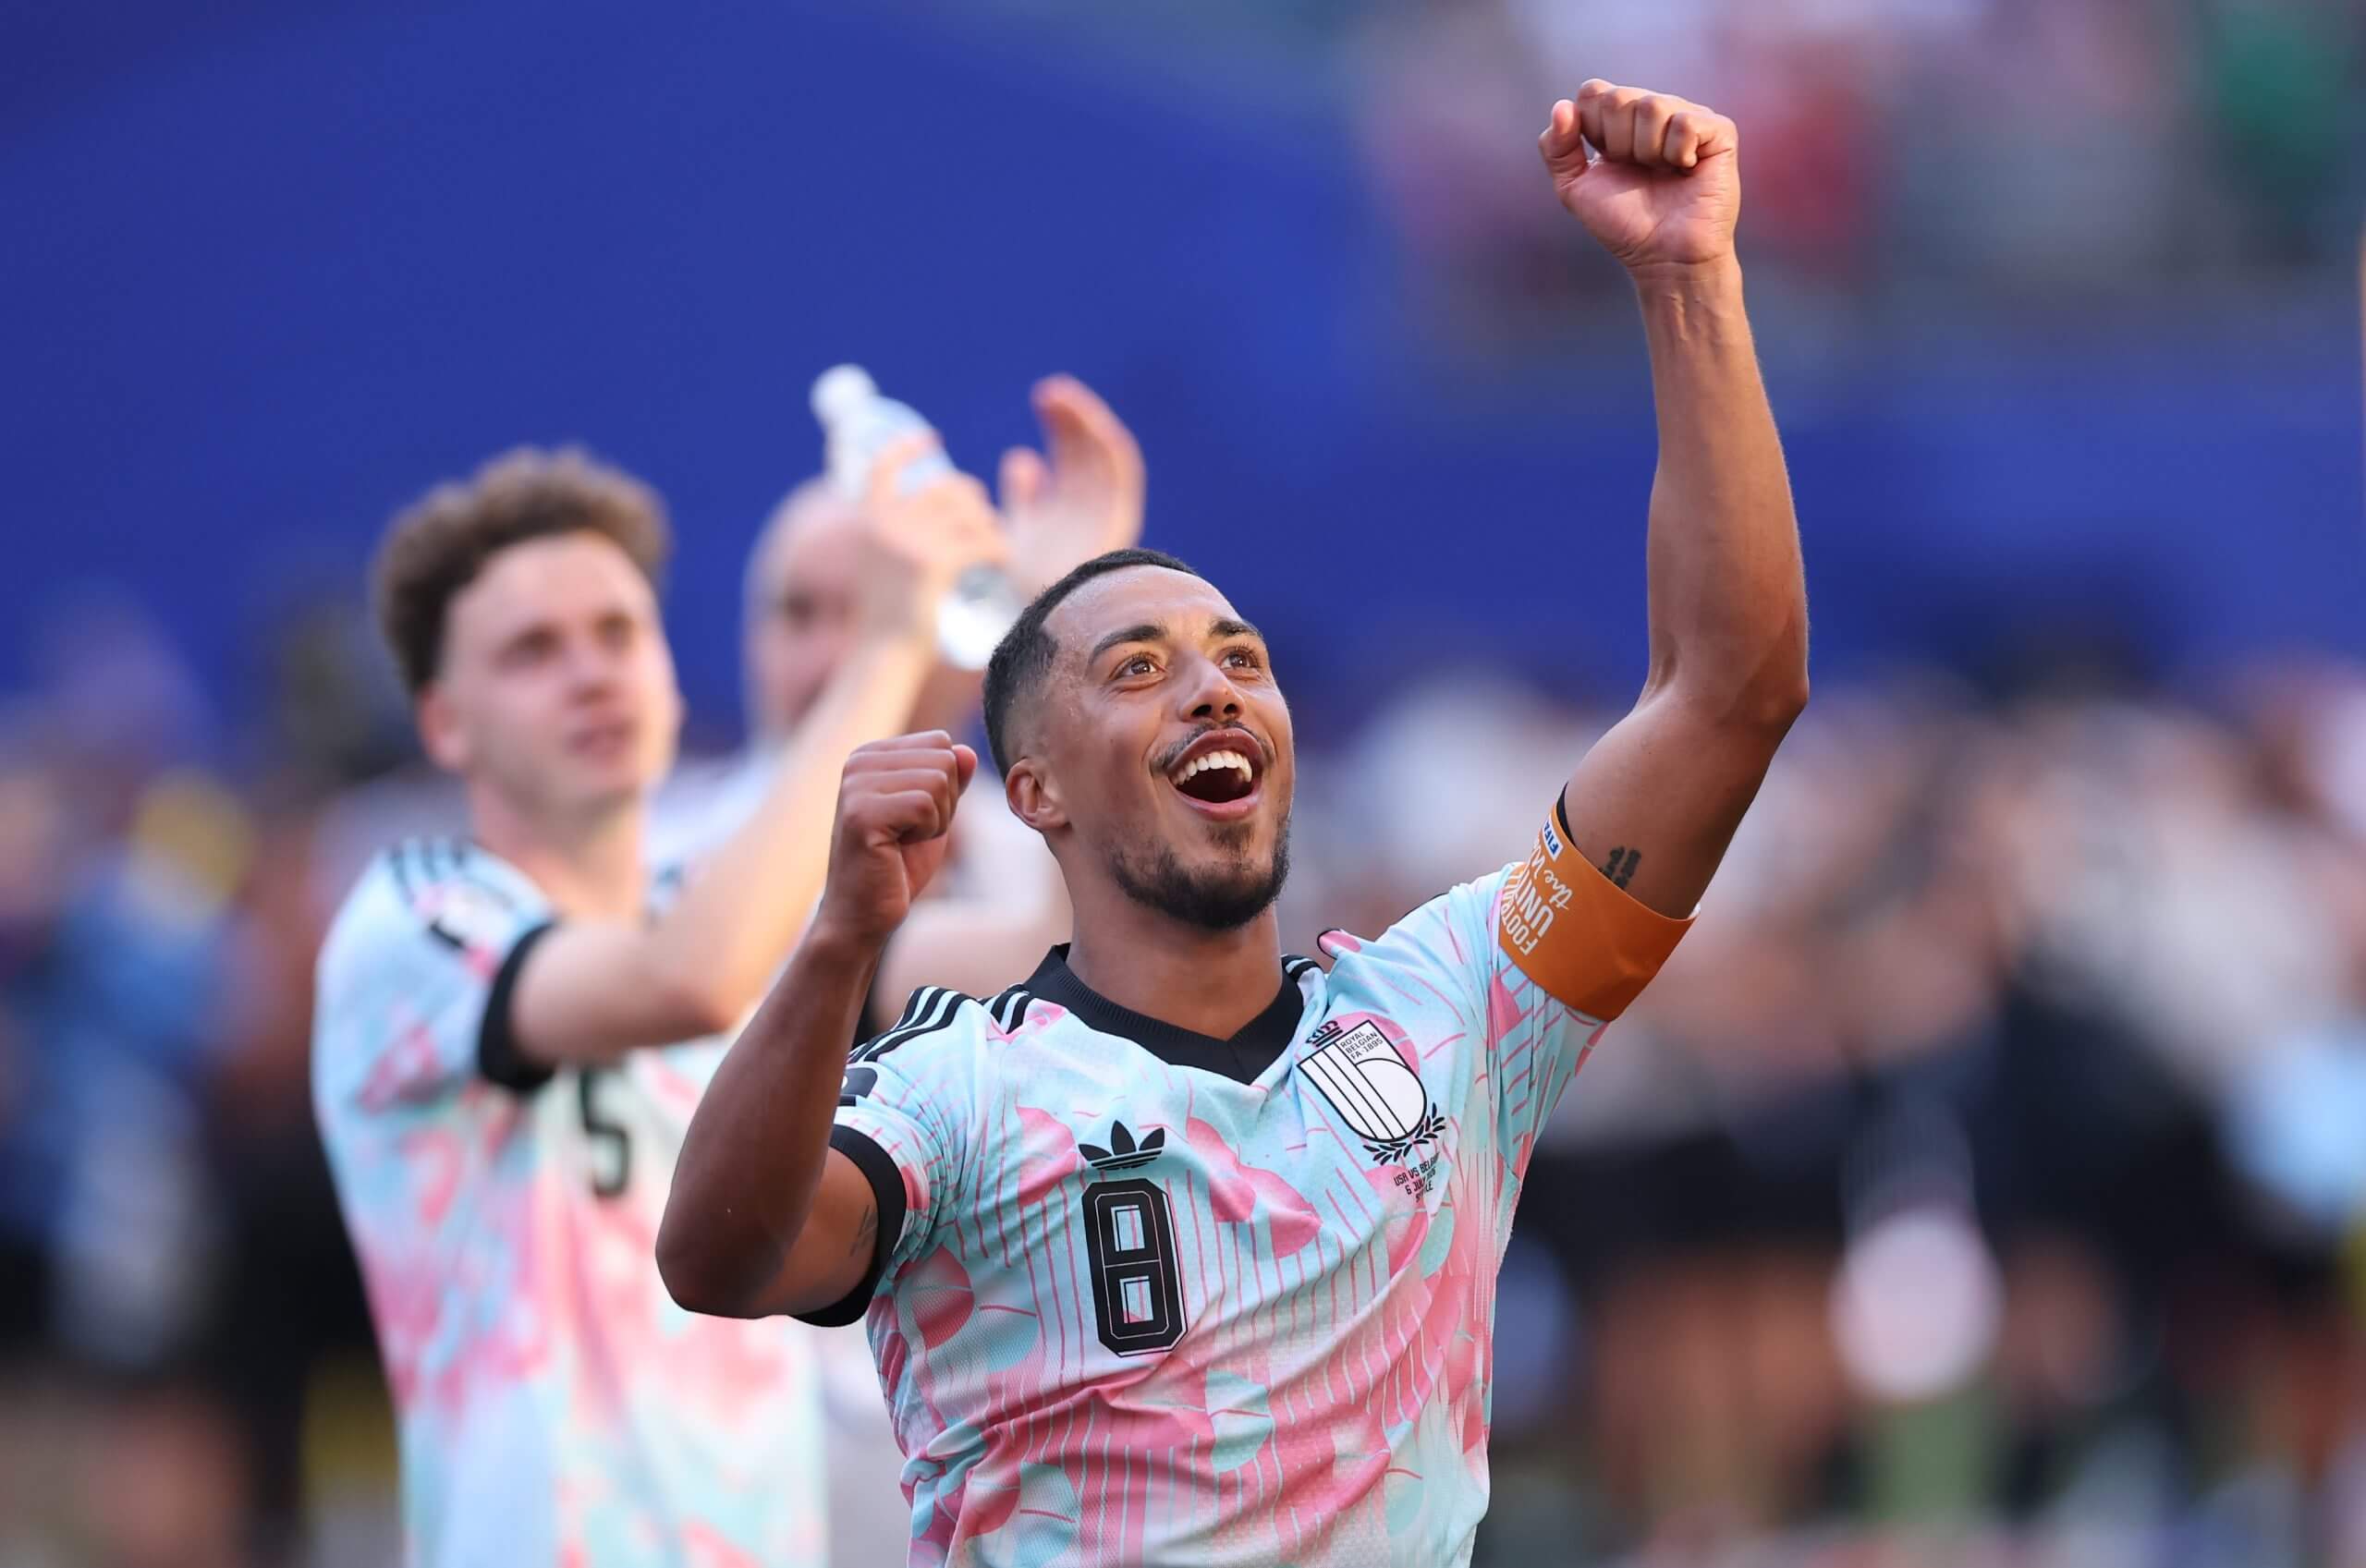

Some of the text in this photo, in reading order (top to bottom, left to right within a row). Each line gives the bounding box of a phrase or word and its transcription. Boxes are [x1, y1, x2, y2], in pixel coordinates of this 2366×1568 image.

[1543, 820, 1559, 856] FIFA
[1543, 869, 1573, 911] the
[1340, 1031, 1364, 1049] ROYAL
[1345, 1031, 1378, 1054] BELGIAN
[1350, 1051, 1363, 1060] FA
[579, 1064, 631, 1199] 5
[1394, 1172, 1409, 1186] USA
[1408, 1166, 1421, 1179] VS
[1405, 1184, 1412, 1195] 6
[1081, 1178, 1189, 1358] 8
